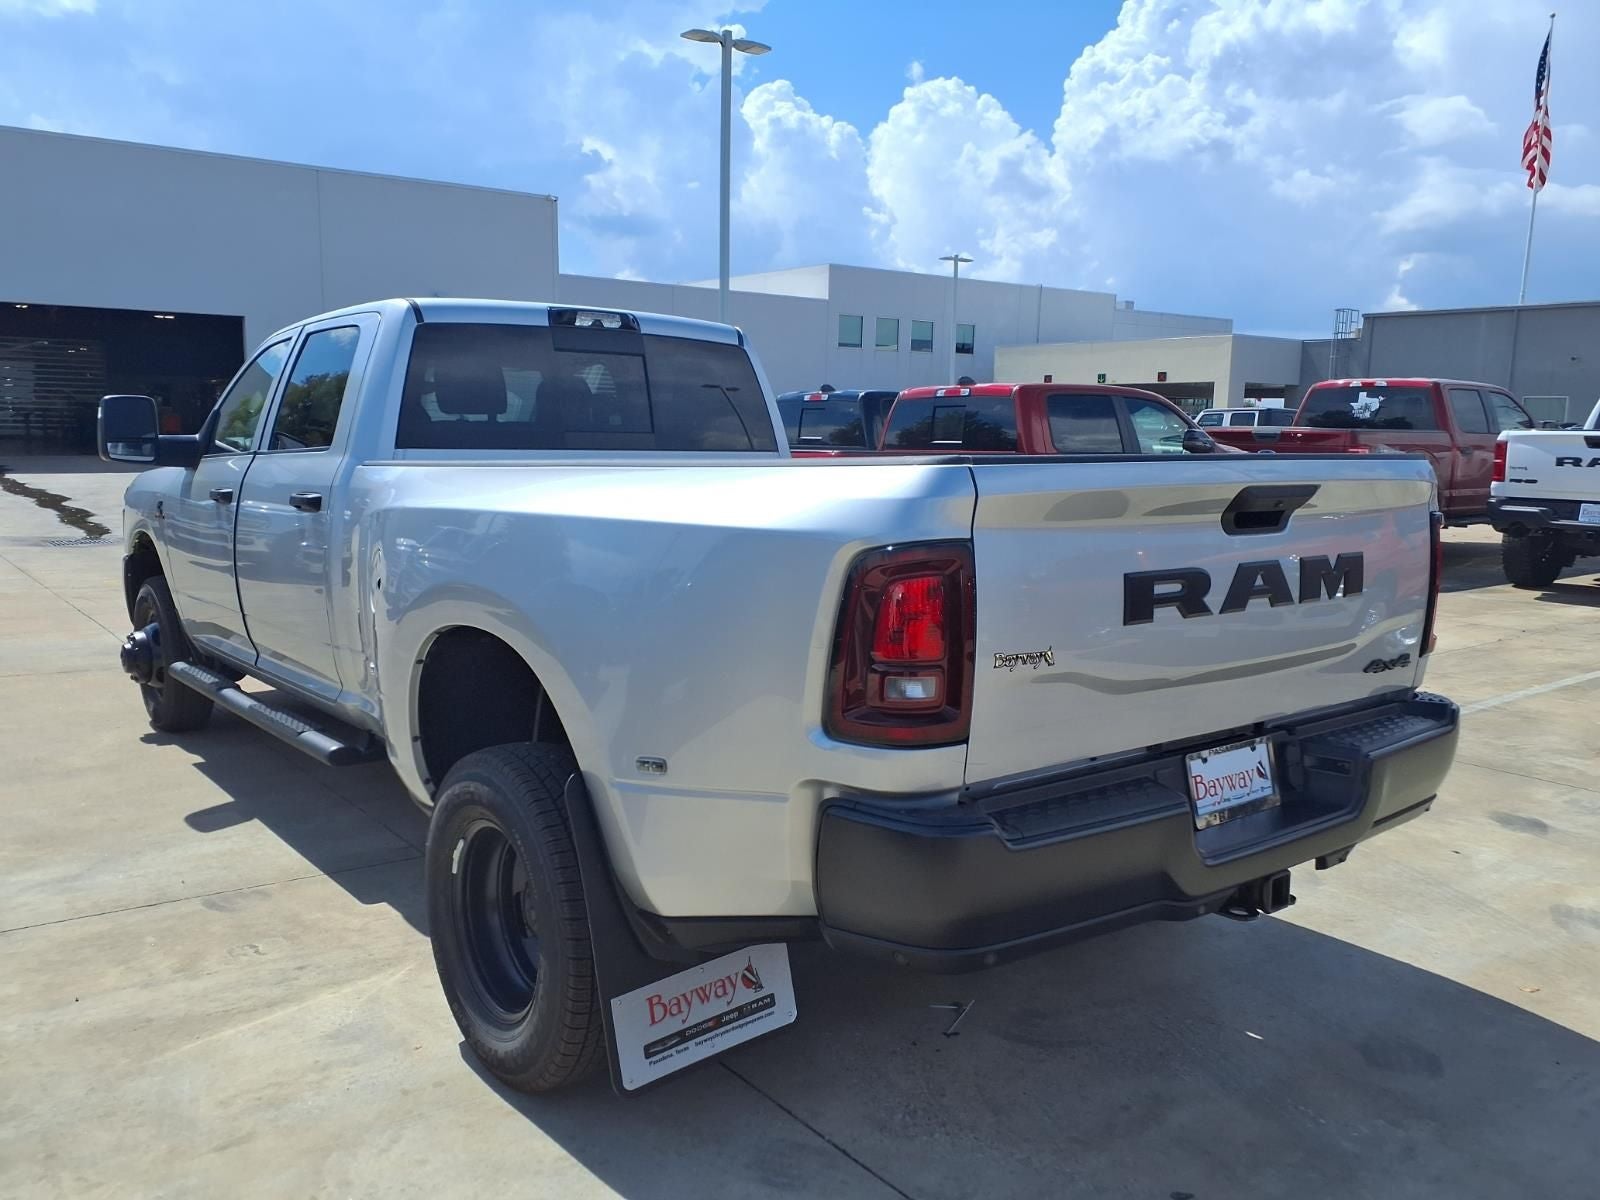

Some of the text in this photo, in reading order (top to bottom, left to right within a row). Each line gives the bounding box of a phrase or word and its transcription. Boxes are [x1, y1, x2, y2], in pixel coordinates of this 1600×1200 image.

[1123, 552, 1364, 626] RAM
[993, 650, 1045, 672] Bayway
[1192, 769, 1254, 805] Bayway
[646, 971, 740, 1027] Bayway
[721, 1011, 740, 1023] Jeep
[751, 998, 771, 1009] RAM
